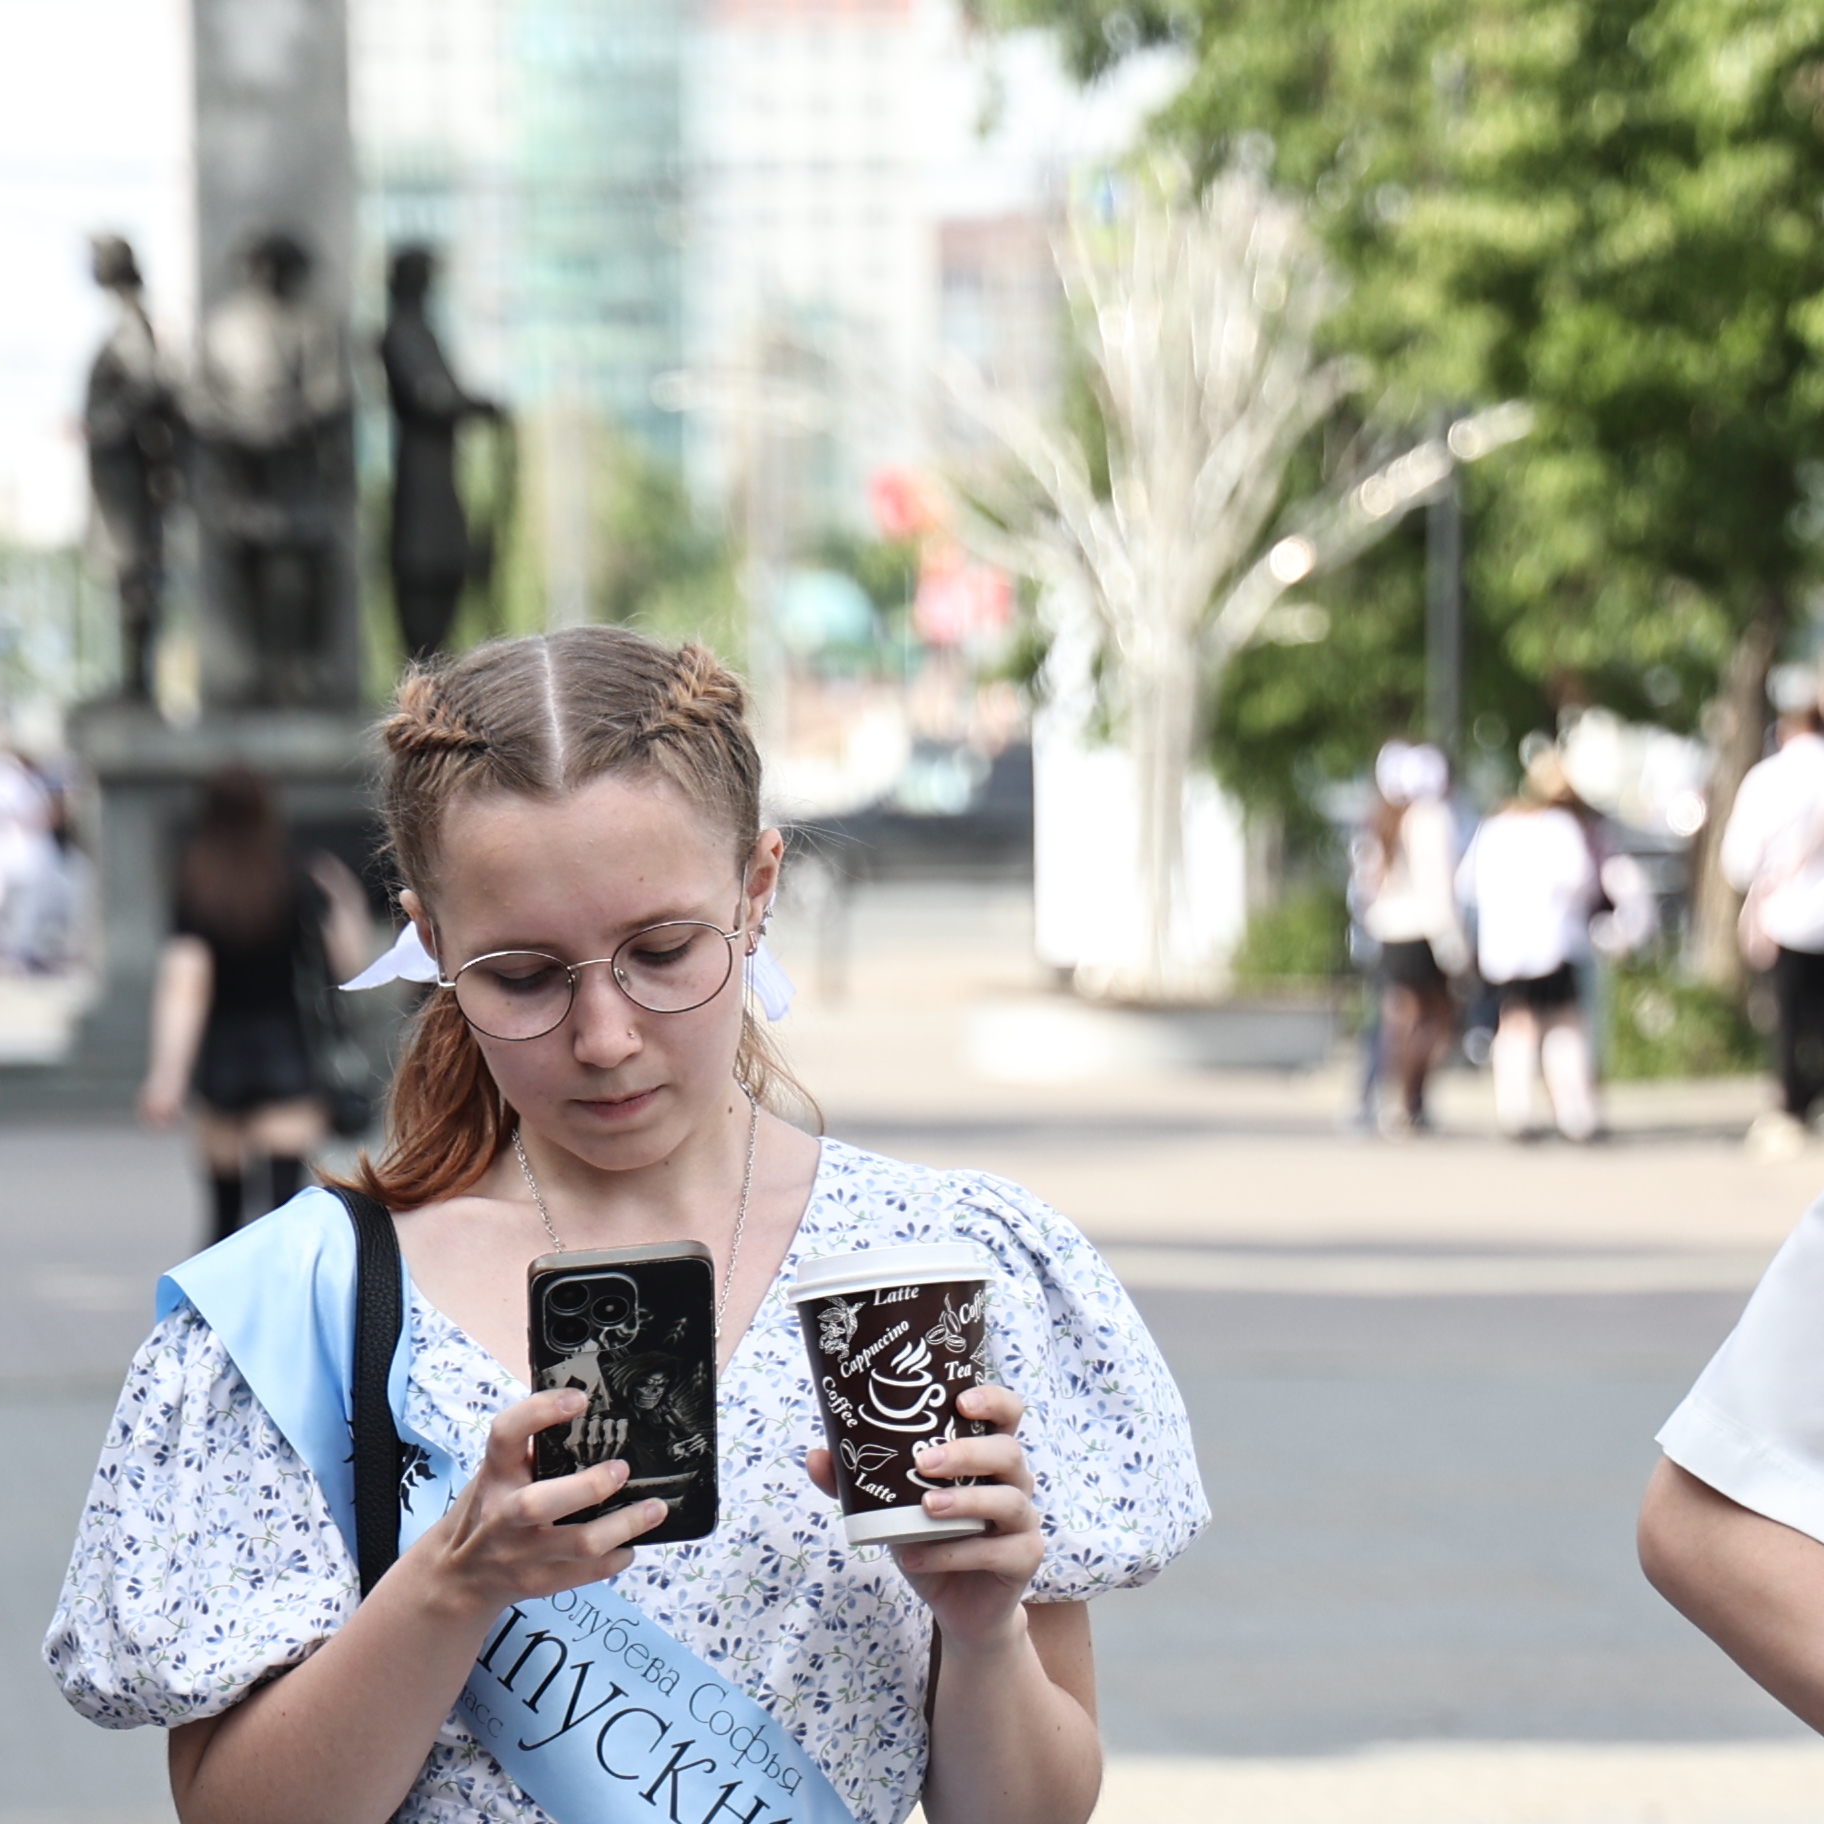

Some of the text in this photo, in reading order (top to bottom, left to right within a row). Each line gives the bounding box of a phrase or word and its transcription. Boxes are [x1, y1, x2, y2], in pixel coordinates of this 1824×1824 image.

[873, 1285, 920, 1306] Latte
[840, 1320, 910, 1378] Cappuccino
[944, 1360, 972, 1381] Tea
[822, 1376, 859, 1428] Coffee
[854, 1472, 897, 1503] Latte
[542, 1588, 805, 1798] олубева Софья
